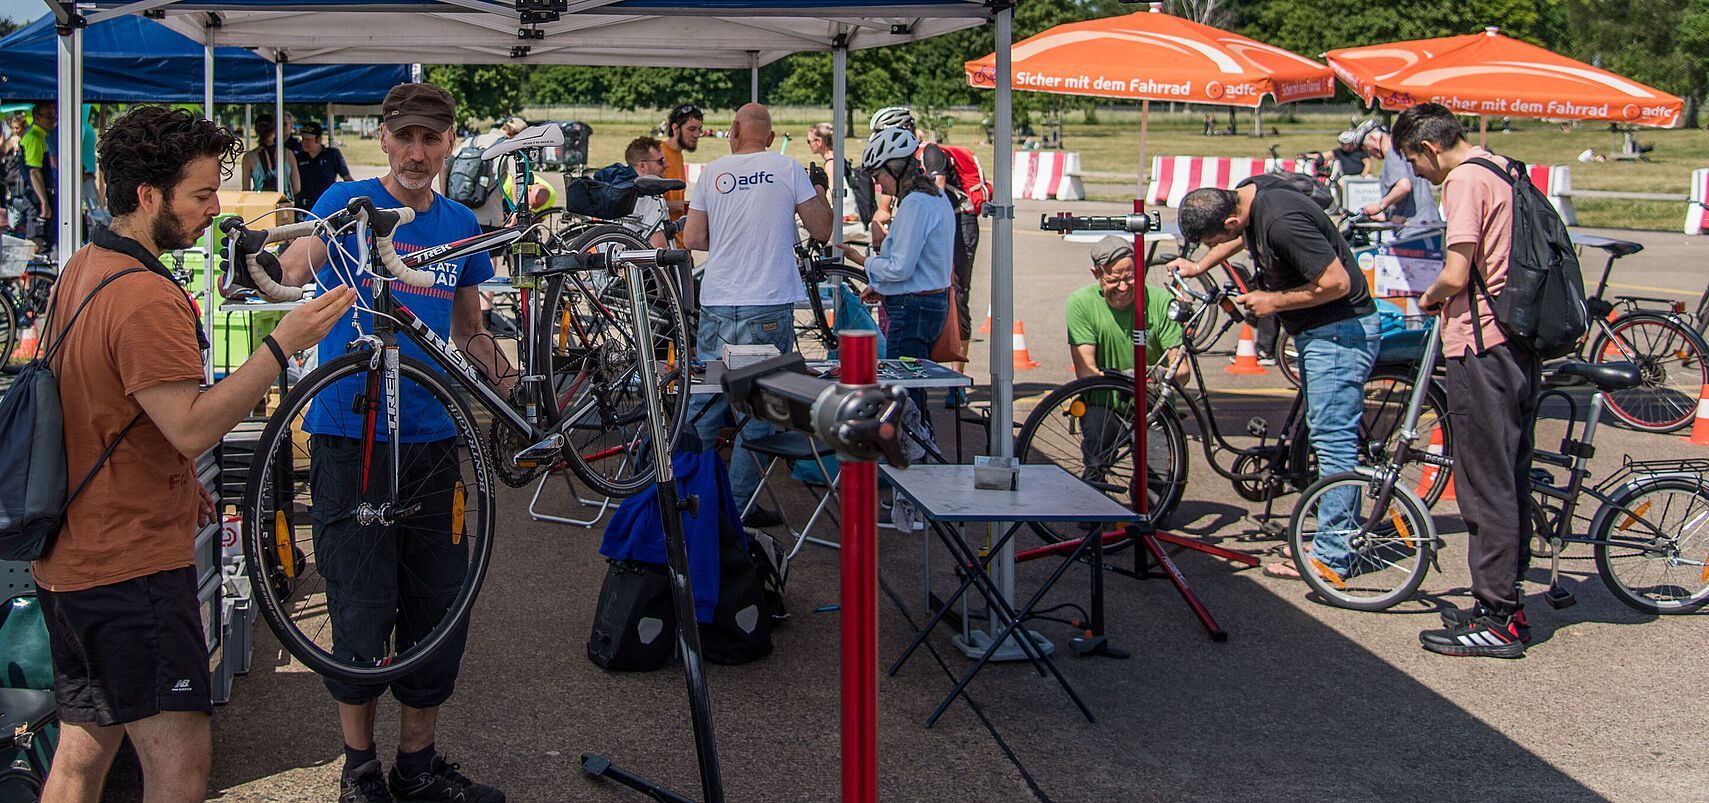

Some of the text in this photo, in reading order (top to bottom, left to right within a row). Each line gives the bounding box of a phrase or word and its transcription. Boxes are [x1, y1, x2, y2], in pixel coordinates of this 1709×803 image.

[1016, 71, 1192, 96] Sicher mit dem Fahrrad
[1225, 83, 1257, 96] adfc
[1481, 98, 1508, 112] mit
[1510, 98, 1543, 113] dem
[1547, 100, 1609, 118] Fahrrad
[1642, 105, 1673, 118] adfc
[738, 171, 774, 186] adfc
[414, 243, 453, 264] TREK
[411, 316, 480, 385] TREK
[385, 368, 397, 434] TREK
[448, 403, 486, 493] BONTRAGER
